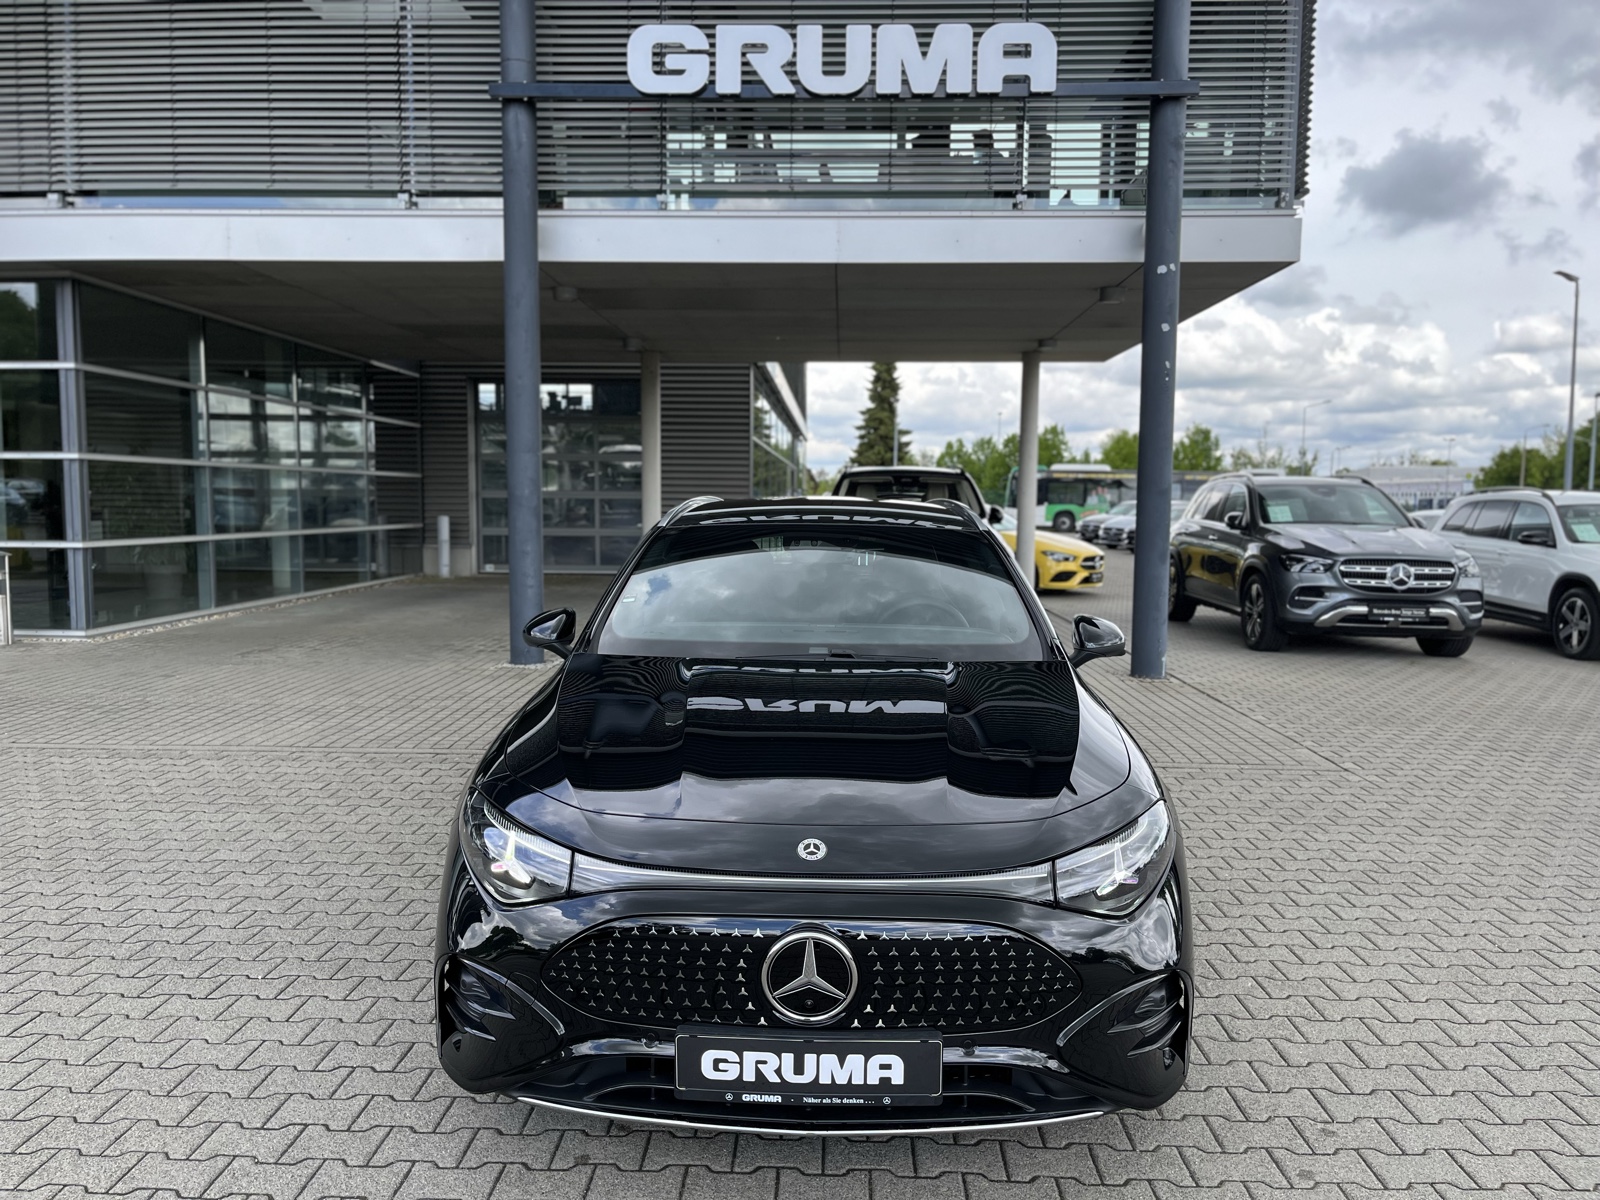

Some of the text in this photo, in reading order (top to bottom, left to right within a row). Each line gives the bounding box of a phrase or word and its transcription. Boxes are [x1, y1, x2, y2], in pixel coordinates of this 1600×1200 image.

[626, 22, 1058, 95] GRUMA
[700, 1049, 905, 1085] GRUMA
[741, 1093, 782, 1103] GRUMA
[803, 1096, 822, 1104] Näher
[822, 1096, 831, 1104] als
[832, 1096, 842, 1104] Sie
[842, 1096, 864, 1104] denken
